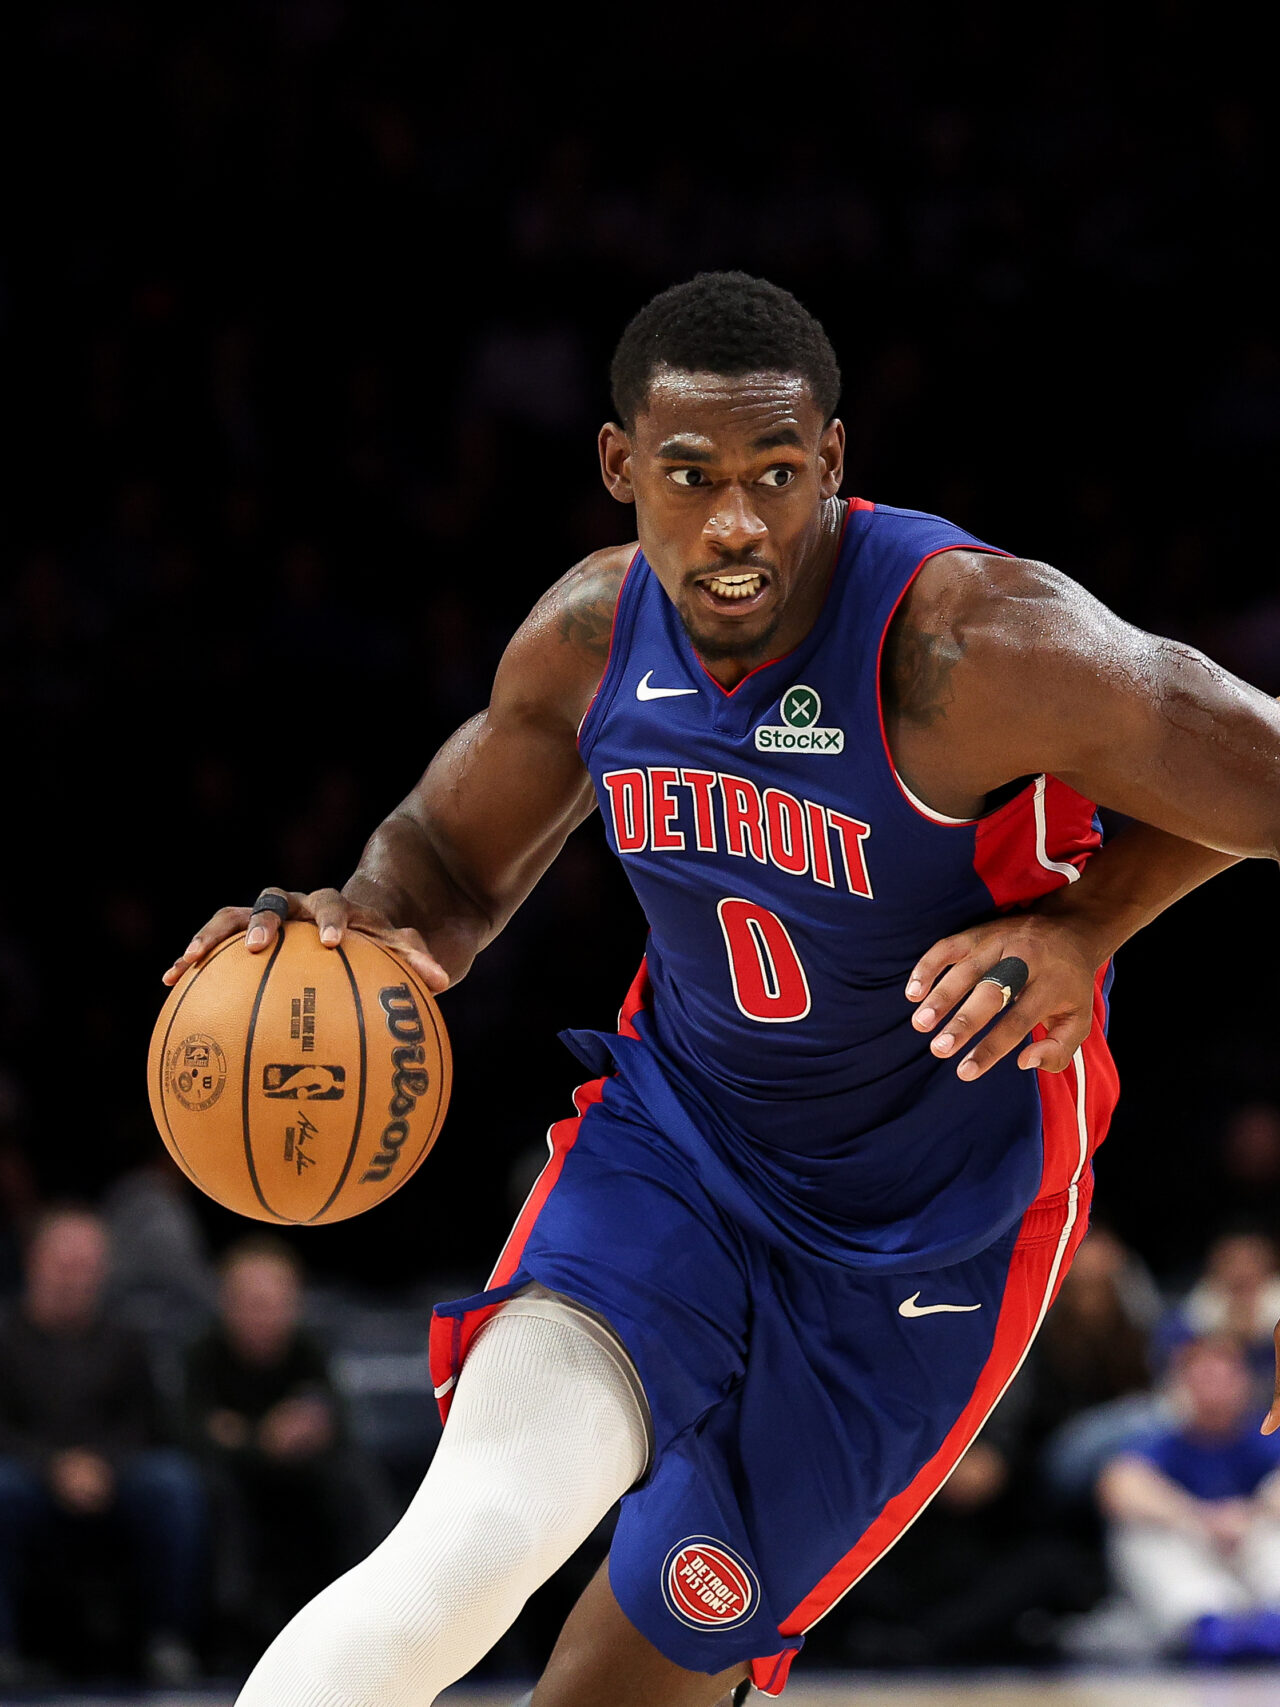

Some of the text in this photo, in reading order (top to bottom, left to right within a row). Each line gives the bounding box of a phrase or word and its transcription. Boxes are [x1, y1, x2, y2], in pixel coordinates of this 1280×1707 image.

[758, 730, 840, 750] StockX
[602, 767, 874, 900] DETROIT
[717, 897, 812, 1023] 0
[358, 982, 430, 1185] Wilson
[679, 1563, 731, 1615] PISTONS
[690, 1554, 741, 1606] DETROIT
